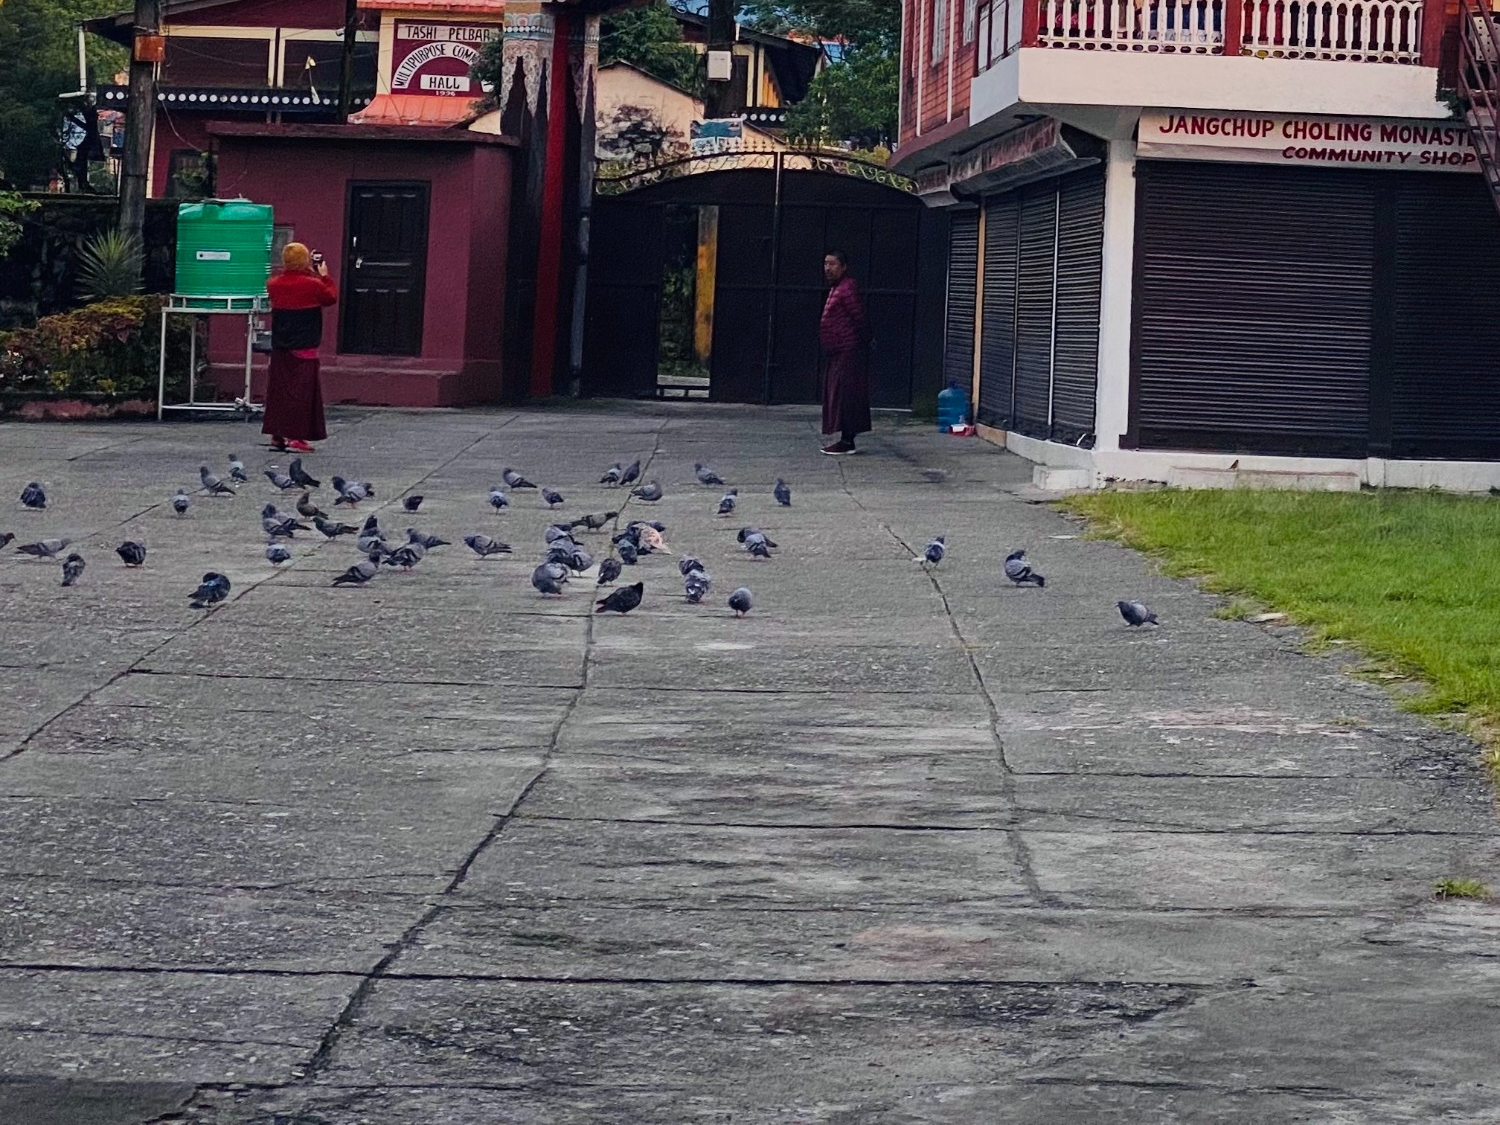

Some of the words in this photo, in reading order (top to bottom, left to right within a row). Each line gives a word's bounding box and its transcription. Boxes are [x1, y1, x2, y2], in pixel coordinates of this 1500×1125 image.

[405, 25, 437, 39] TASHI
[394, 43, 446, 87] MULTIPURPOSE
[429, 76, 460, 89] HALL
[1159, 114, 1275, 139] JANGCHUP
[1282, 120, 1372, 142] CHOLING
[1282, 146, 1412, 164] COMMUNITY
[1419, 150, 1476, 166] SHOP
